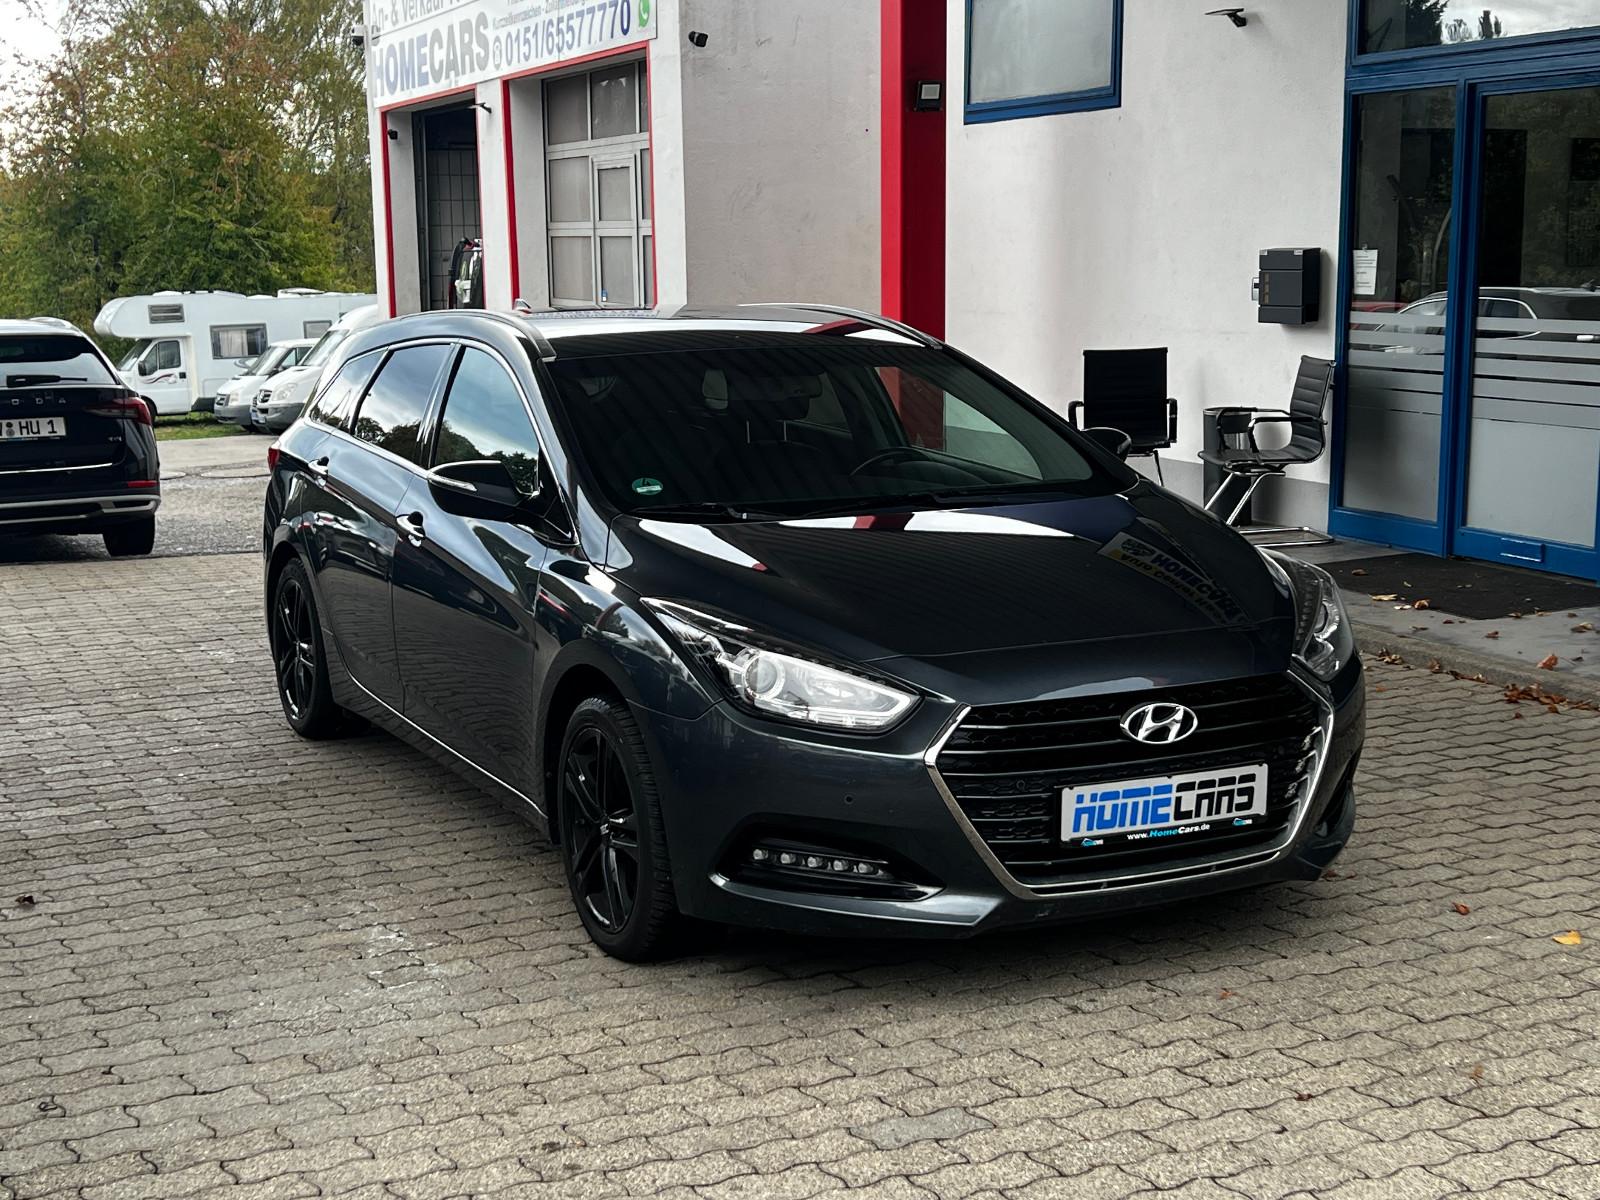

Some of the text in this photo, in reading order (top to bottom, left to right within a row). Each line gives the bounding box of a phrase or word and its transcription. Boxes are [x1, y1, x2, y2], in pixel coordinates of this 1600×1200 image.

[371, 0, 631, 99] HOMECARS 0151/65577770
[18, 420, 41, 436] HU
[47, 419, 57, 434] 1
[1072, 772, 1257, 833] HOMECARS
[1126, 823, 1211, 841] www.HomeCars.de
